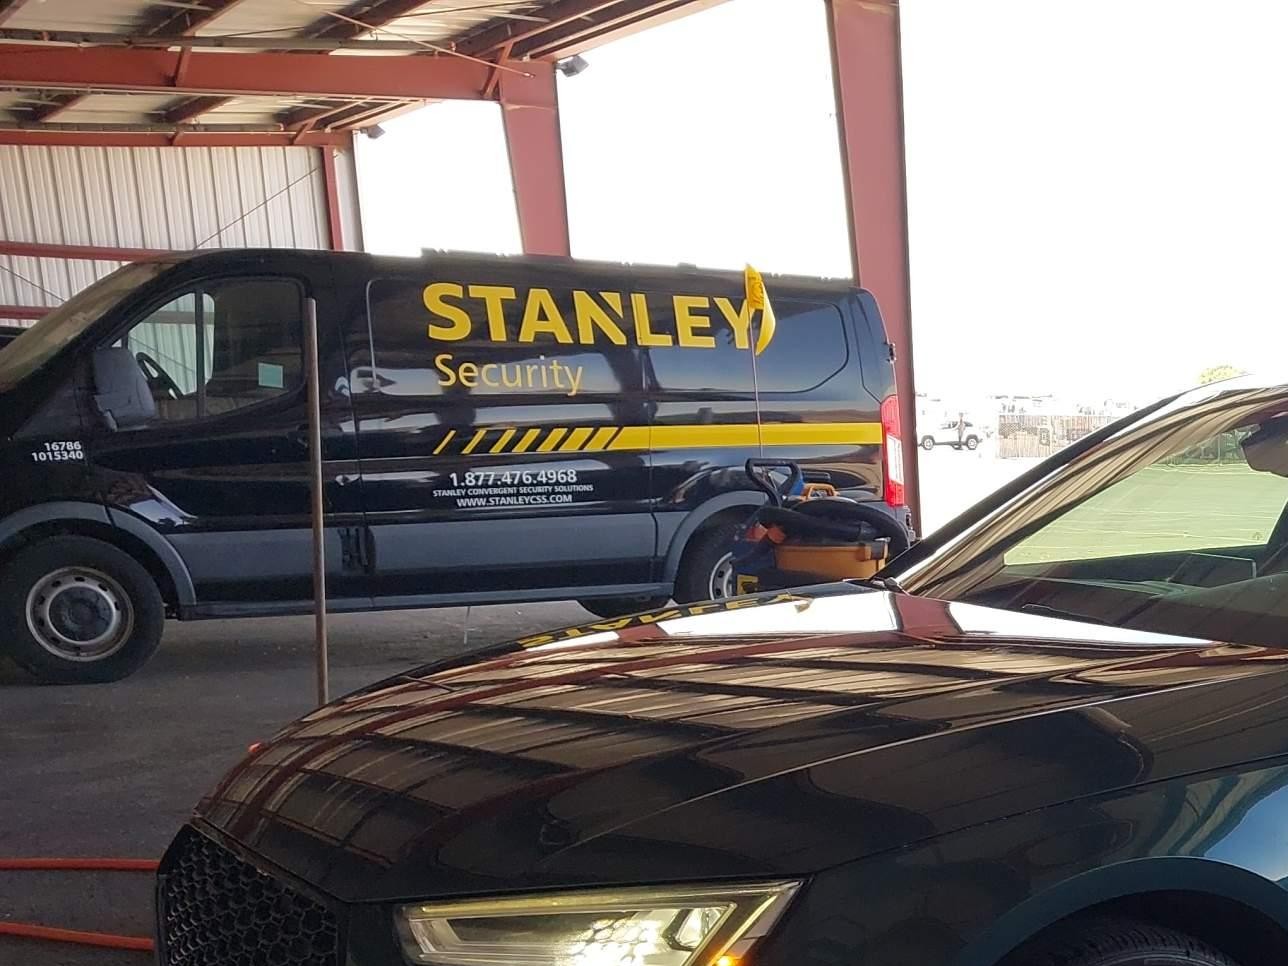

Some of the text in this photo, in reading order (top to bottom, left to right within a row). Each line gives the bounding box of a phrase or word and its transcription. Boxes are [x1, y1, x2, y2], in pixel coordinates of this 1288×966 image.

[422, 282, 751, 349] STANLEY
[433, 354, 583, 397] Security
[44, 441, 82, 451] 16786
[31, 450, 84, 462] 1015340
[449, 469, 578, 487] 1.877.476.4968
[433, 484, 594, 497] STANLEY CONVERGENT SECURITY SOLUTIONS
[456, 494, 573, 507] WWW.STANLEYCSS.COM
